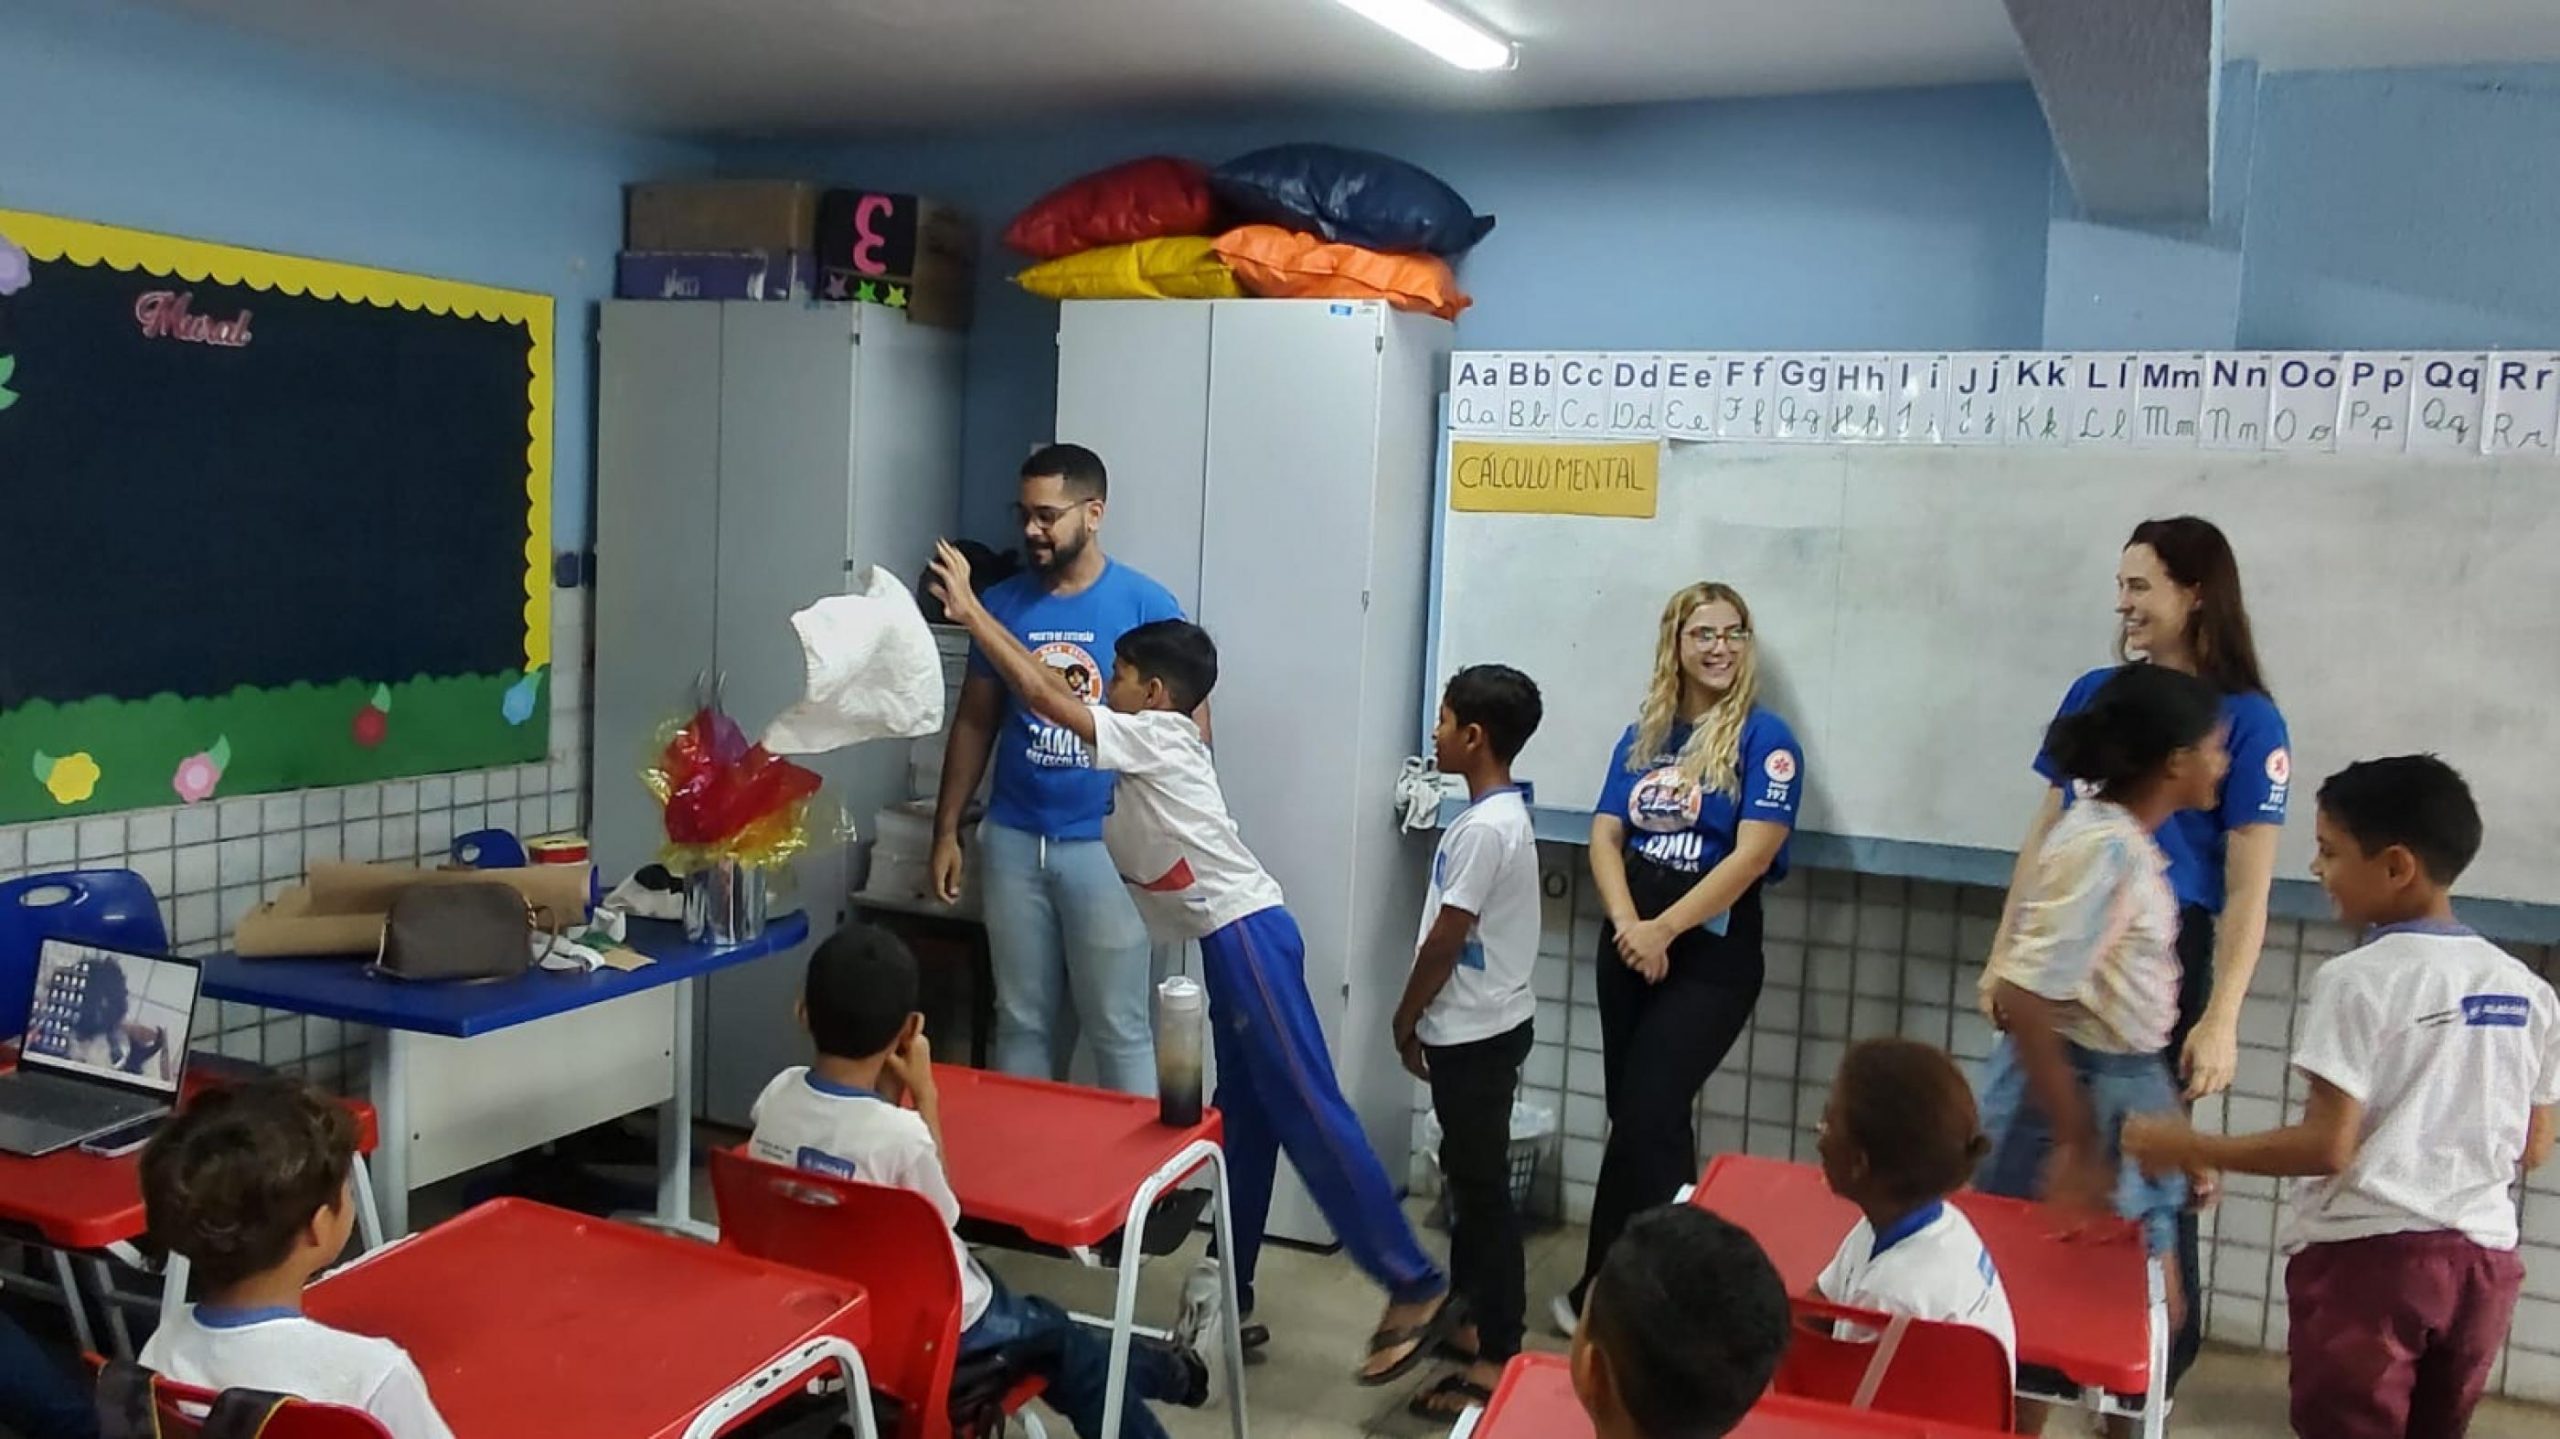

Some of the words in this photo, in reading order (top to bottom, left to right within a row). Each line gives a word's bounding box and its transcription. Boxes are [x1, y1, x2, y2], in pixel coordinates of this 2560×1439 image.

[135, 290, 253, 347] Mural
[1457, 451, 1551, 488] CÁLCULO
[1556, 457, 1648, 491] MENTAL
